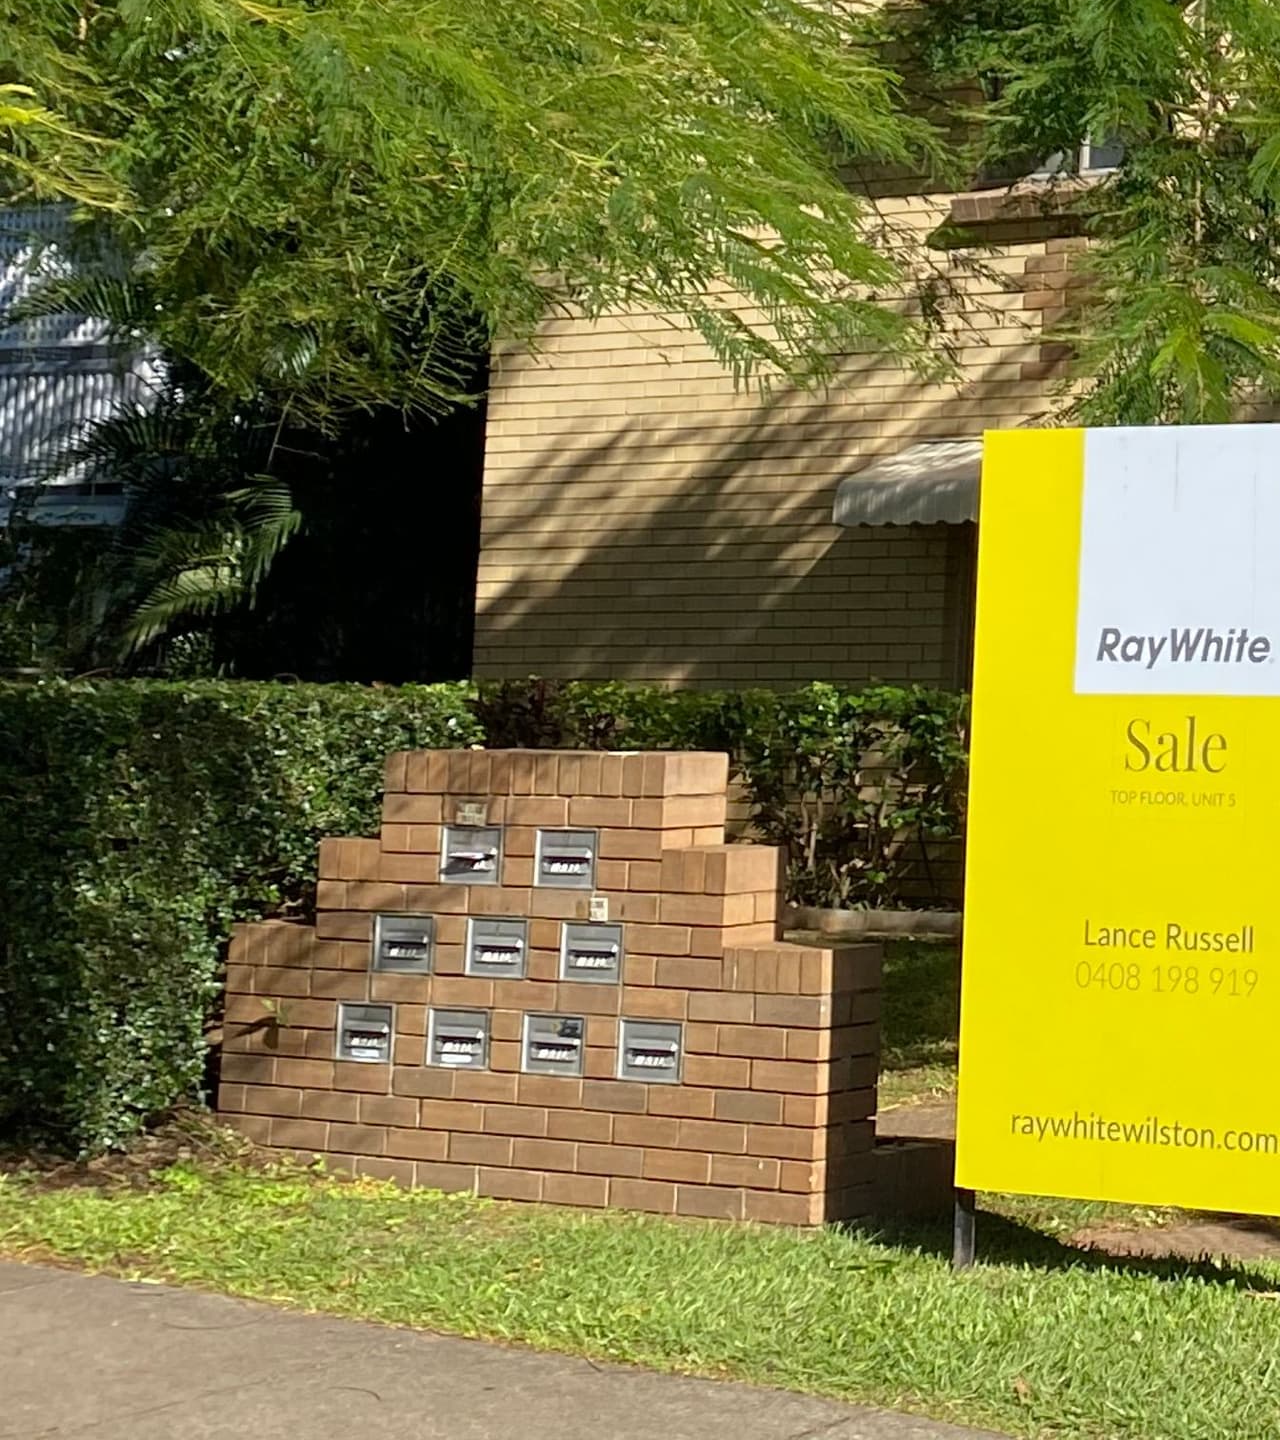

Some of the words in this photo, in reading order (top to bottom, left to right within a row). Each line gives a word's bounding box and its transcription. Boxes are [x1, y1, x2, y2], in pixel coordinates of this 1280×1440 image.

[1125, 715, 1227, 773] Sale
[1111, 790, 1137, 805] TOP
[1192, 792, 1225, 807] UNIT
[1084, 919, 1156, 949] Lance
[1166, 923, 1254, 953] Russell
[1075, 960, 1141, 991] 0408
[1152, 965, 1199, 994] 198
[1208, 967, 1259, 998] 919
